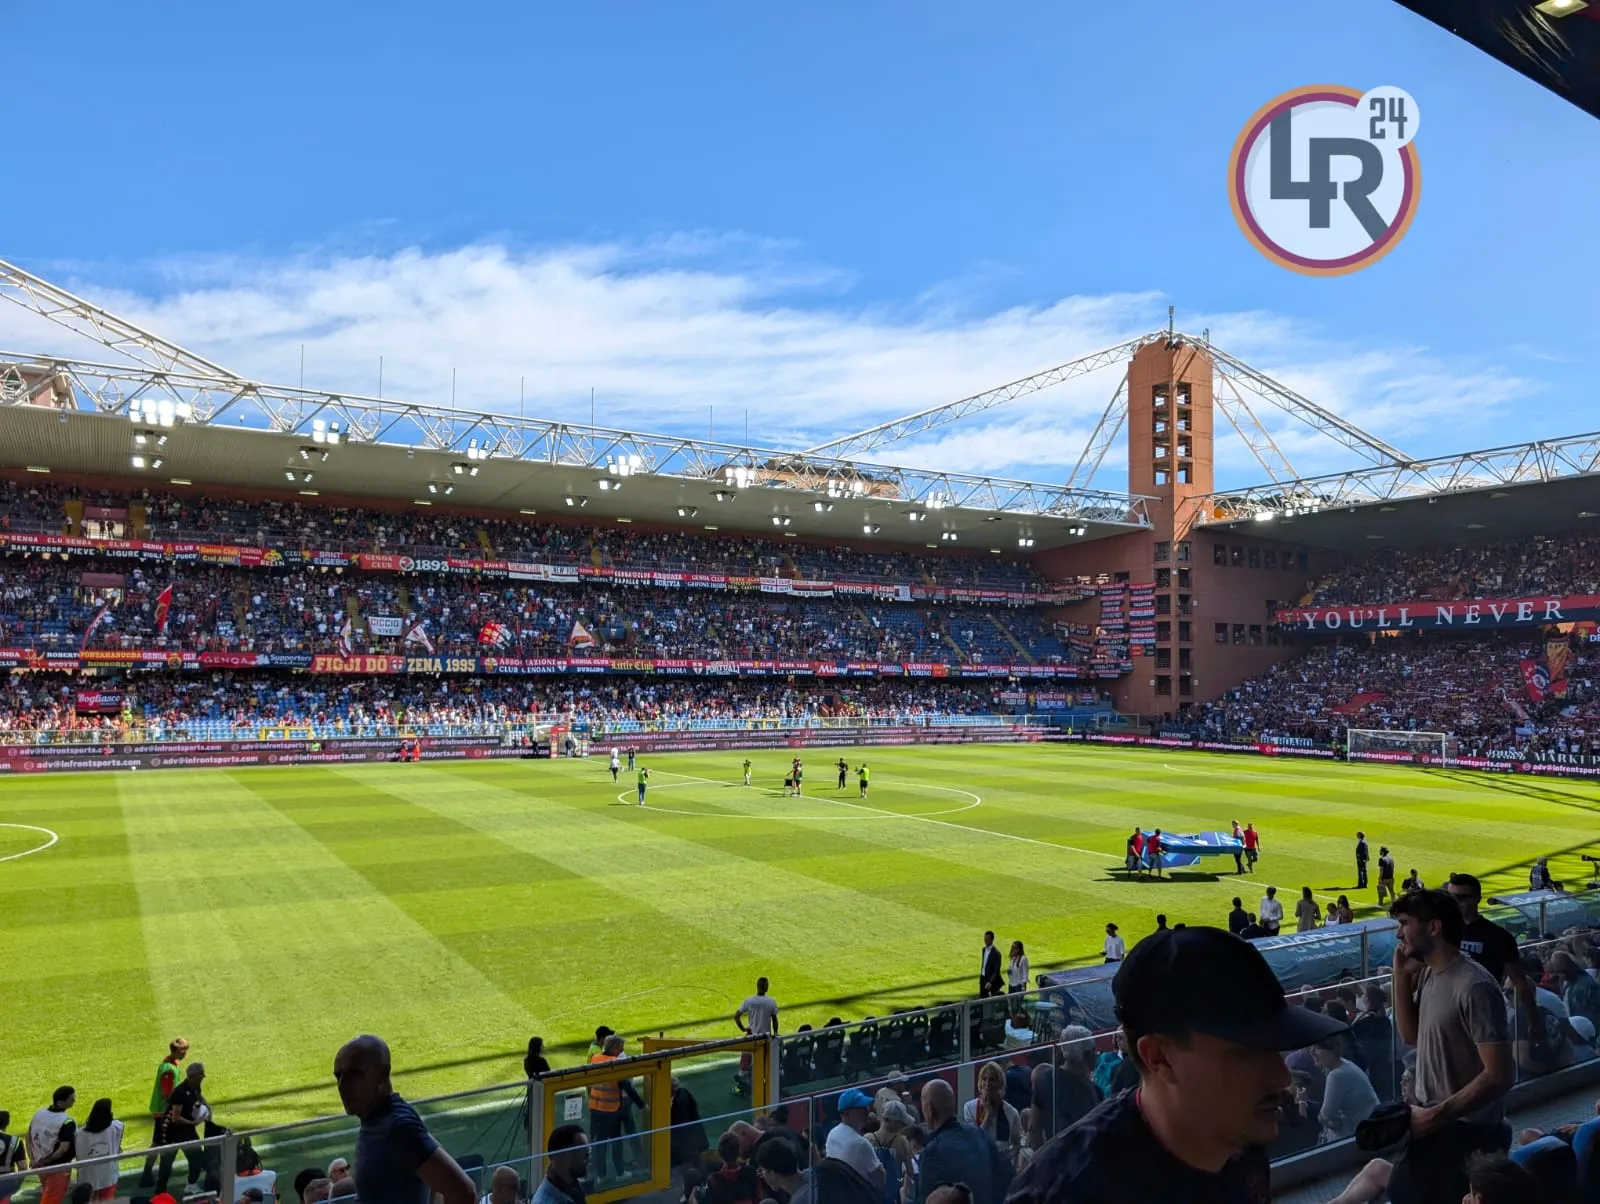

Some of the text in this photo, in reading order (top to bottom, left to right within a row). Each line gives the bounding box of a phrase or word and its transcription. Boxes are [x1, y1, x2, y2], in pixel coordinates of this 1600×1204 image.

[11, 544, 26, 552] SAN
[67, 548, 140, 558] PIEVE LIGURE
[365, 554, 393, 562] GENOA
[371, 561, 393, 569] CLUB
[415, 559, 449, 573] 1893
[834, 584, 873, 595] TORRIGLIA
[1302, 600, 1564, 630] YOU'LL NEVER
[204, 657, 250, 666] GENOA
[270, 654, 312, 663] Supporters
[407, 657, 476, 674] ZENA 1995
[499, 665, 519, 673] CLUB
[78, 693, 121, 706] Bogliasco
[163, 756, 258, 766] adv@infrontsports.com
[279, 752, 366, 762] adv@infrontsports.com
[36, 759, 141, 770] adv@infrontsports.com
